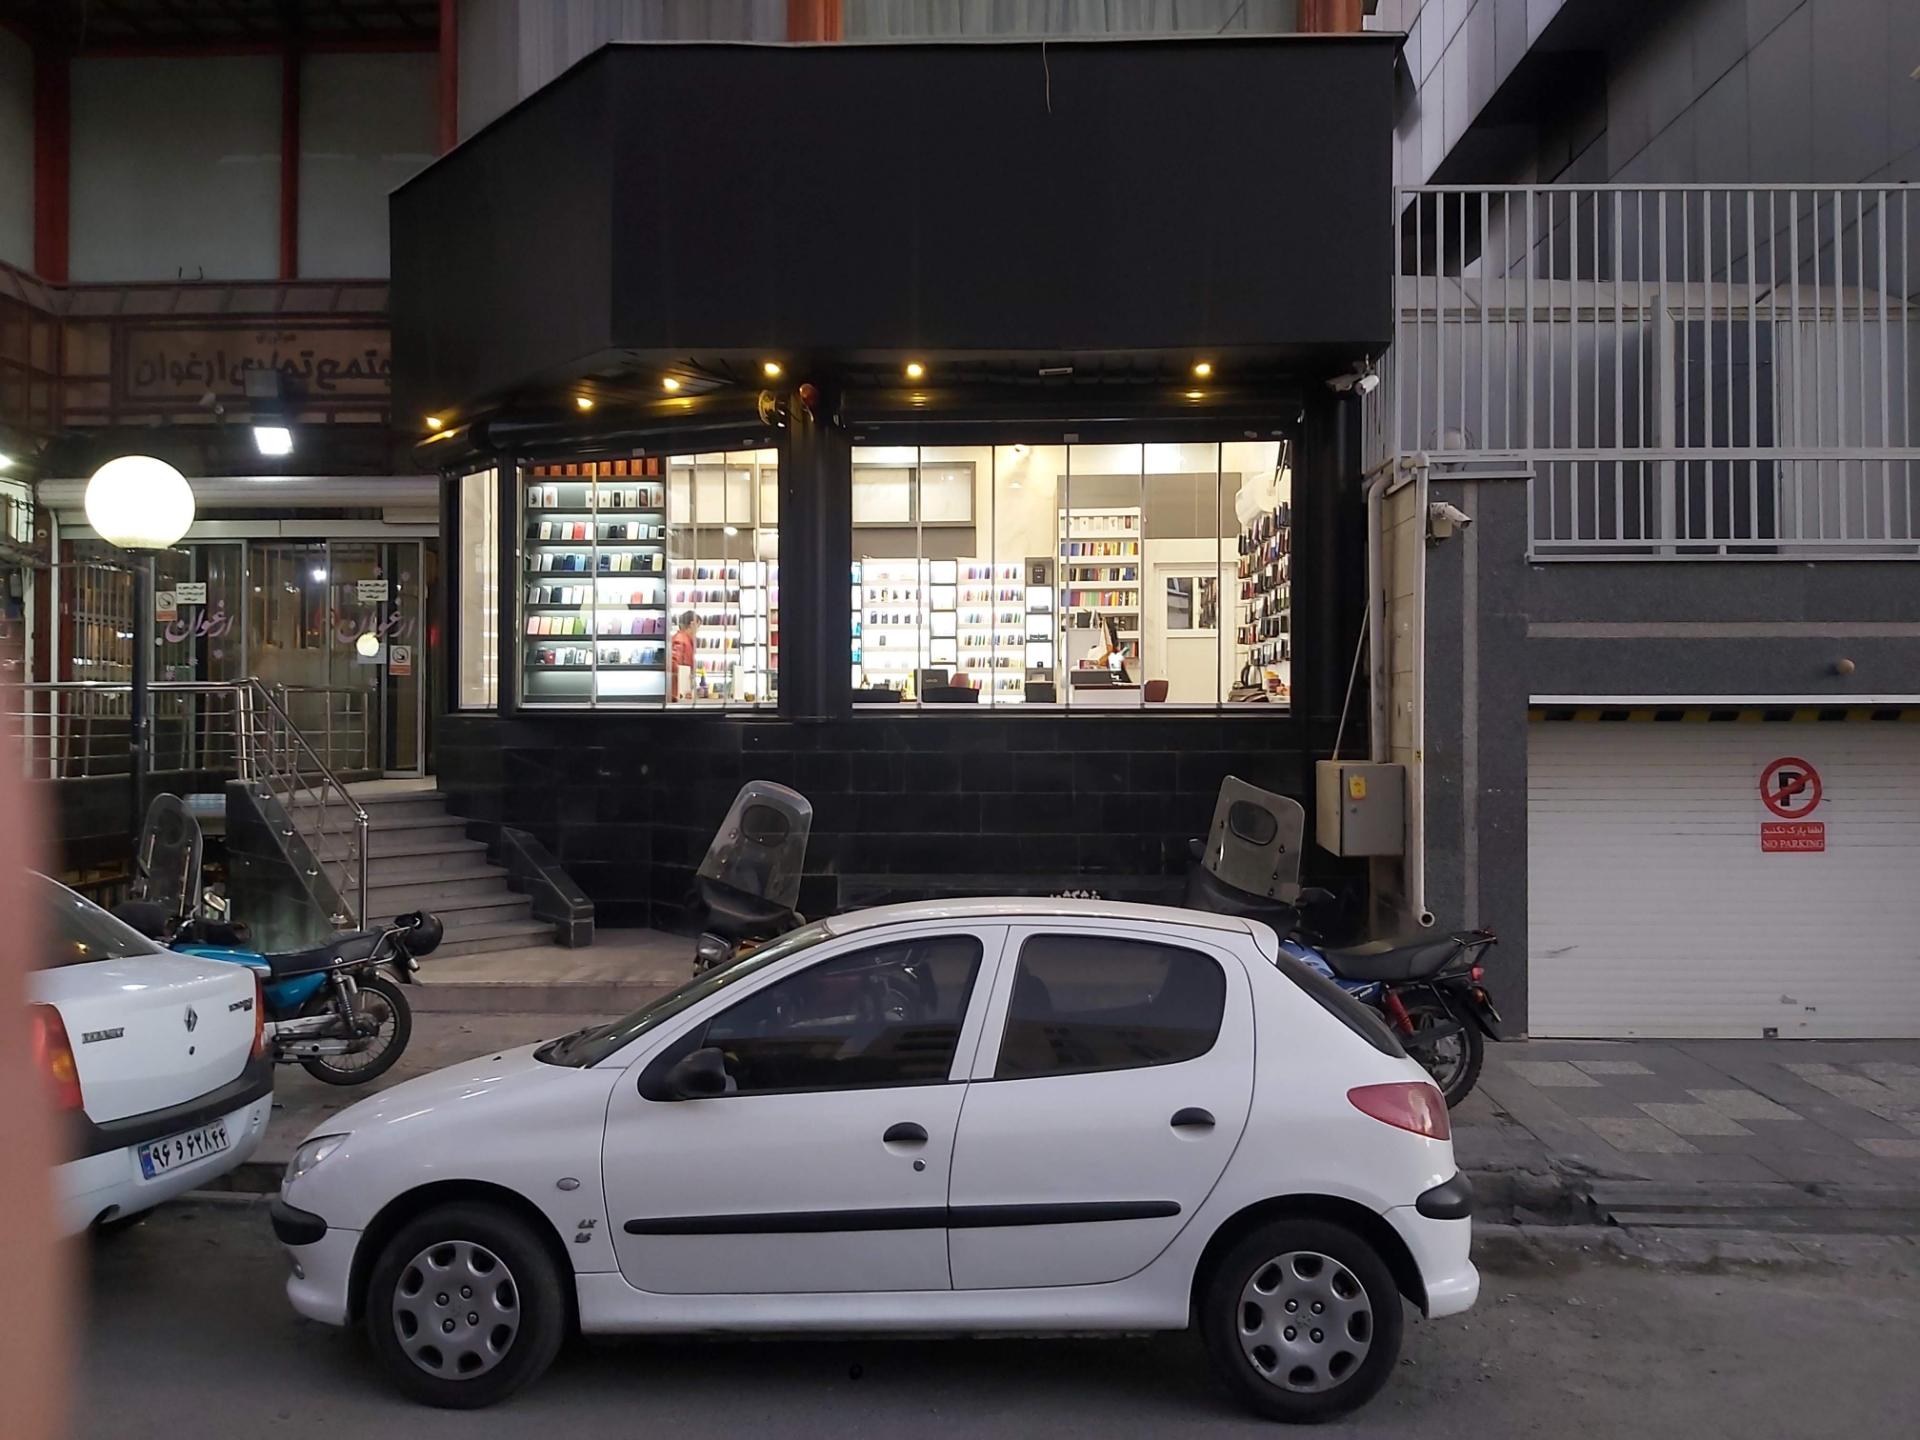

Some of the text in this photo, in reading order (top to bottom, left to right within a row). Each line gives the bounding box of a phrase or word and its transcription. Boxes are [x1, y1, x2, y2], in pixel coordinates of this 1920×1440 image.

[317, 350, 391, 389] جتمع
[1778, 772, 1806, 807] P
[1763, 839, 1824, 849] NO PARKING
